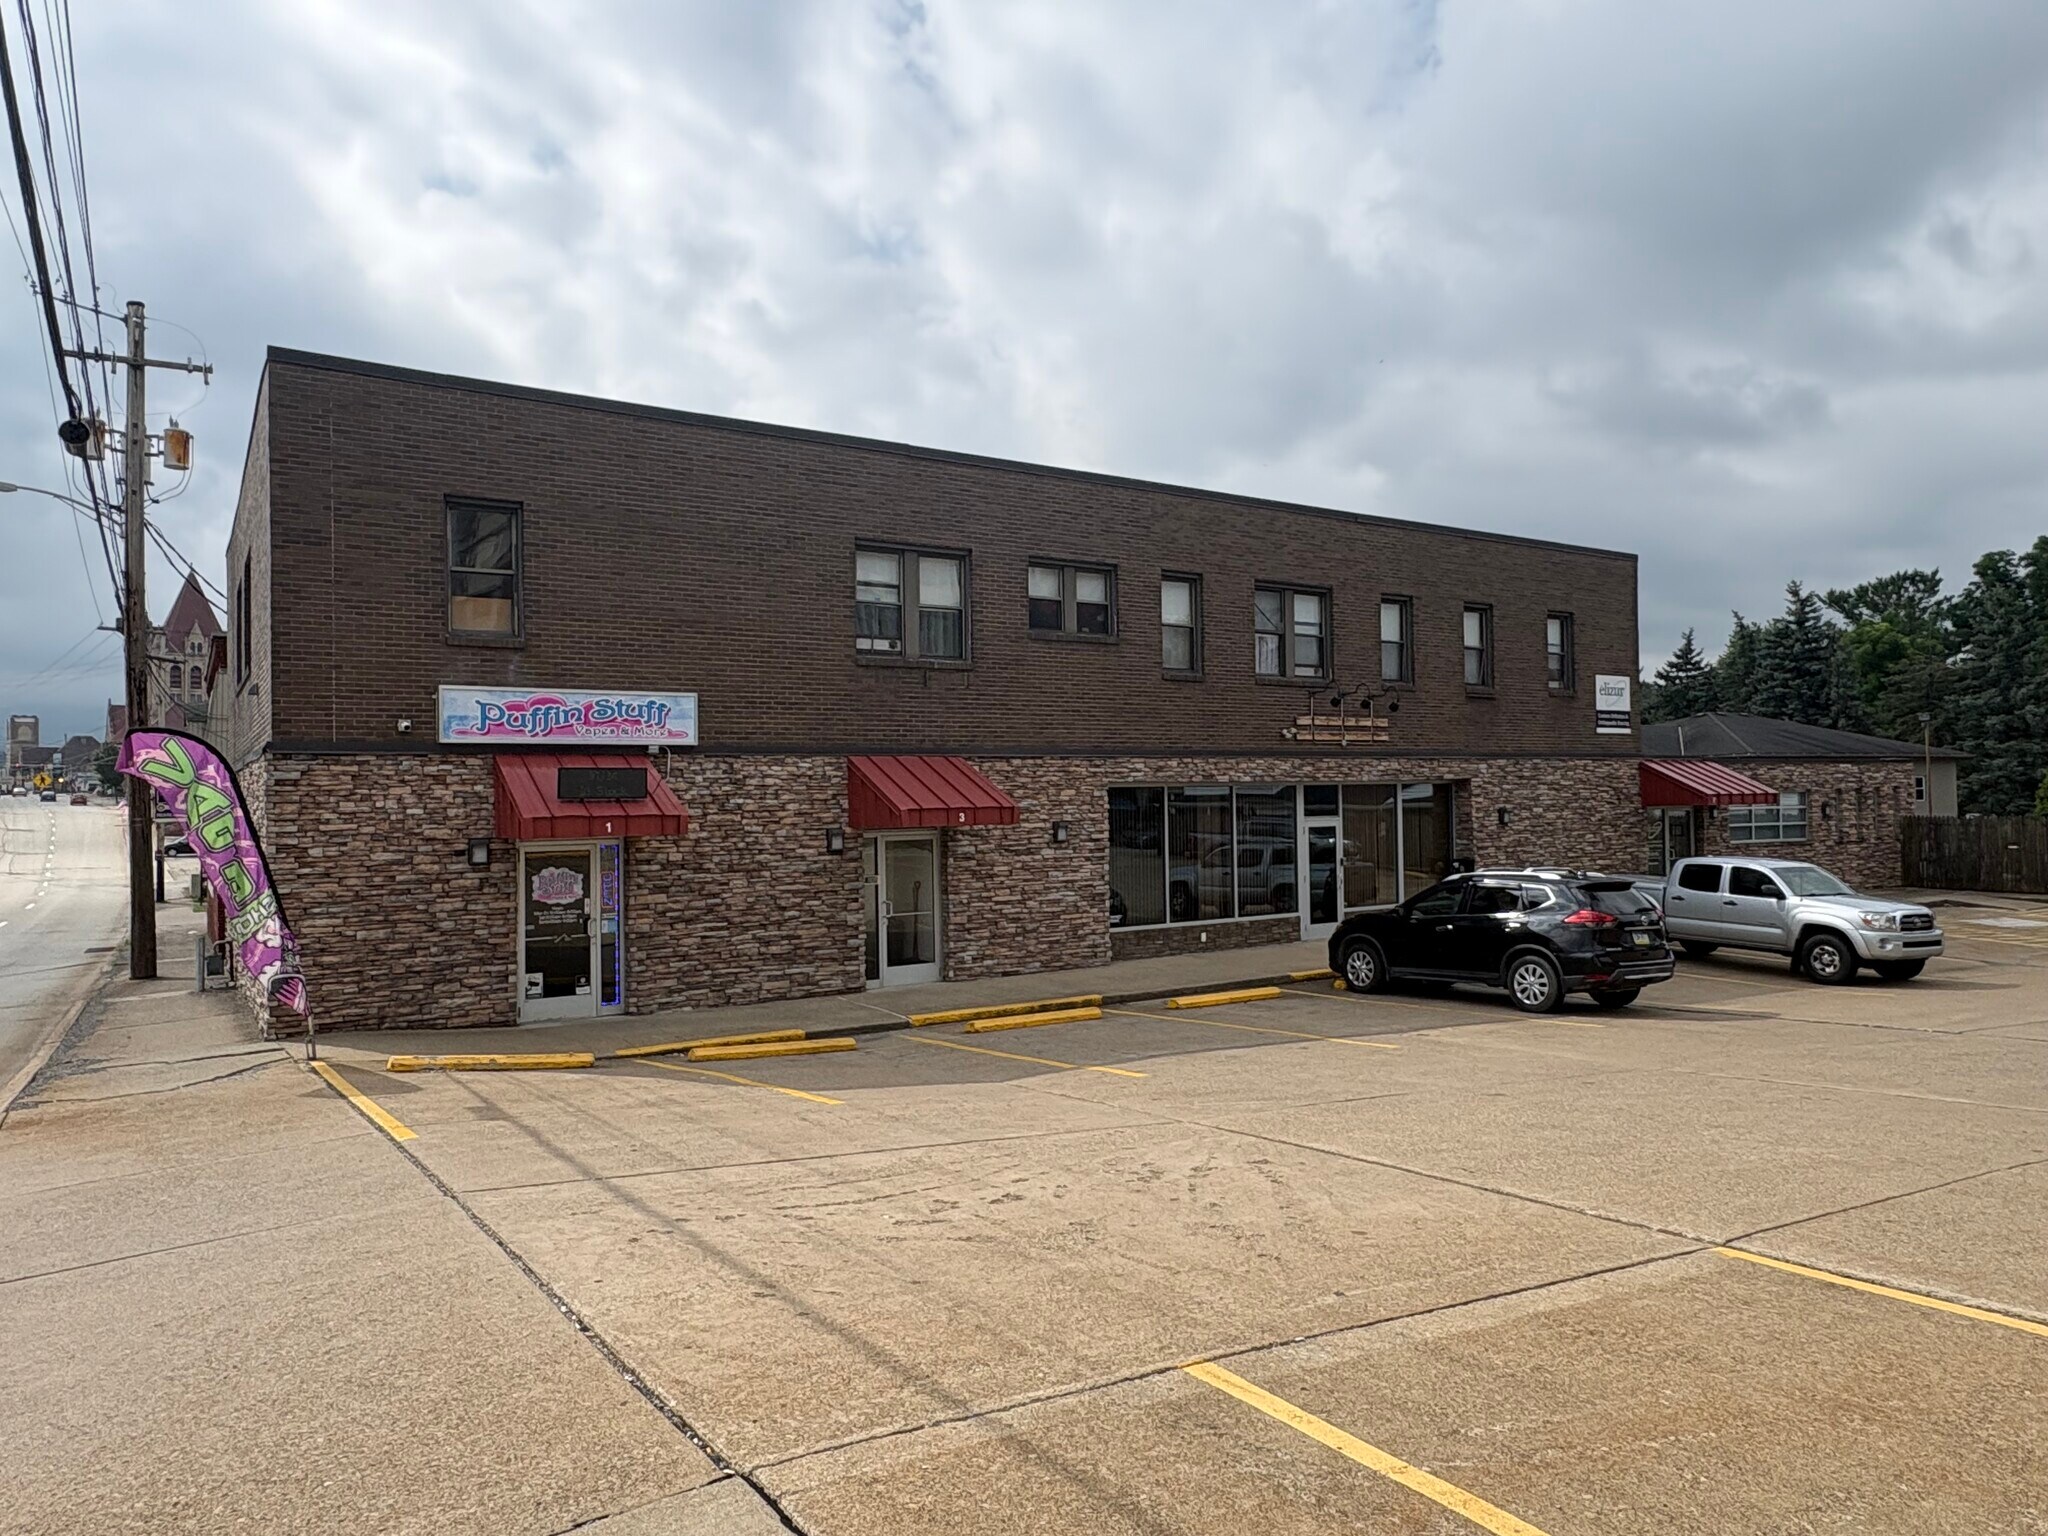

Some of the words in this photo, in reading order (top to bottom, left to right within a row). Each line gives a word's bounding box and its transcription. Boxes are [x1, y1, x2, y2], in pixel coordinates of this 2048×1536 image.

[475, 699, 583, 737] Puffin
[591, 698, 672, 728] Stuff
[575, 724, 616, 736] Vapes
[620, 726, 632, 736] &
[634, 726, 668, 737] More
[958, 812, 965, 822] 3
[604, 822, 612, 833] 1
